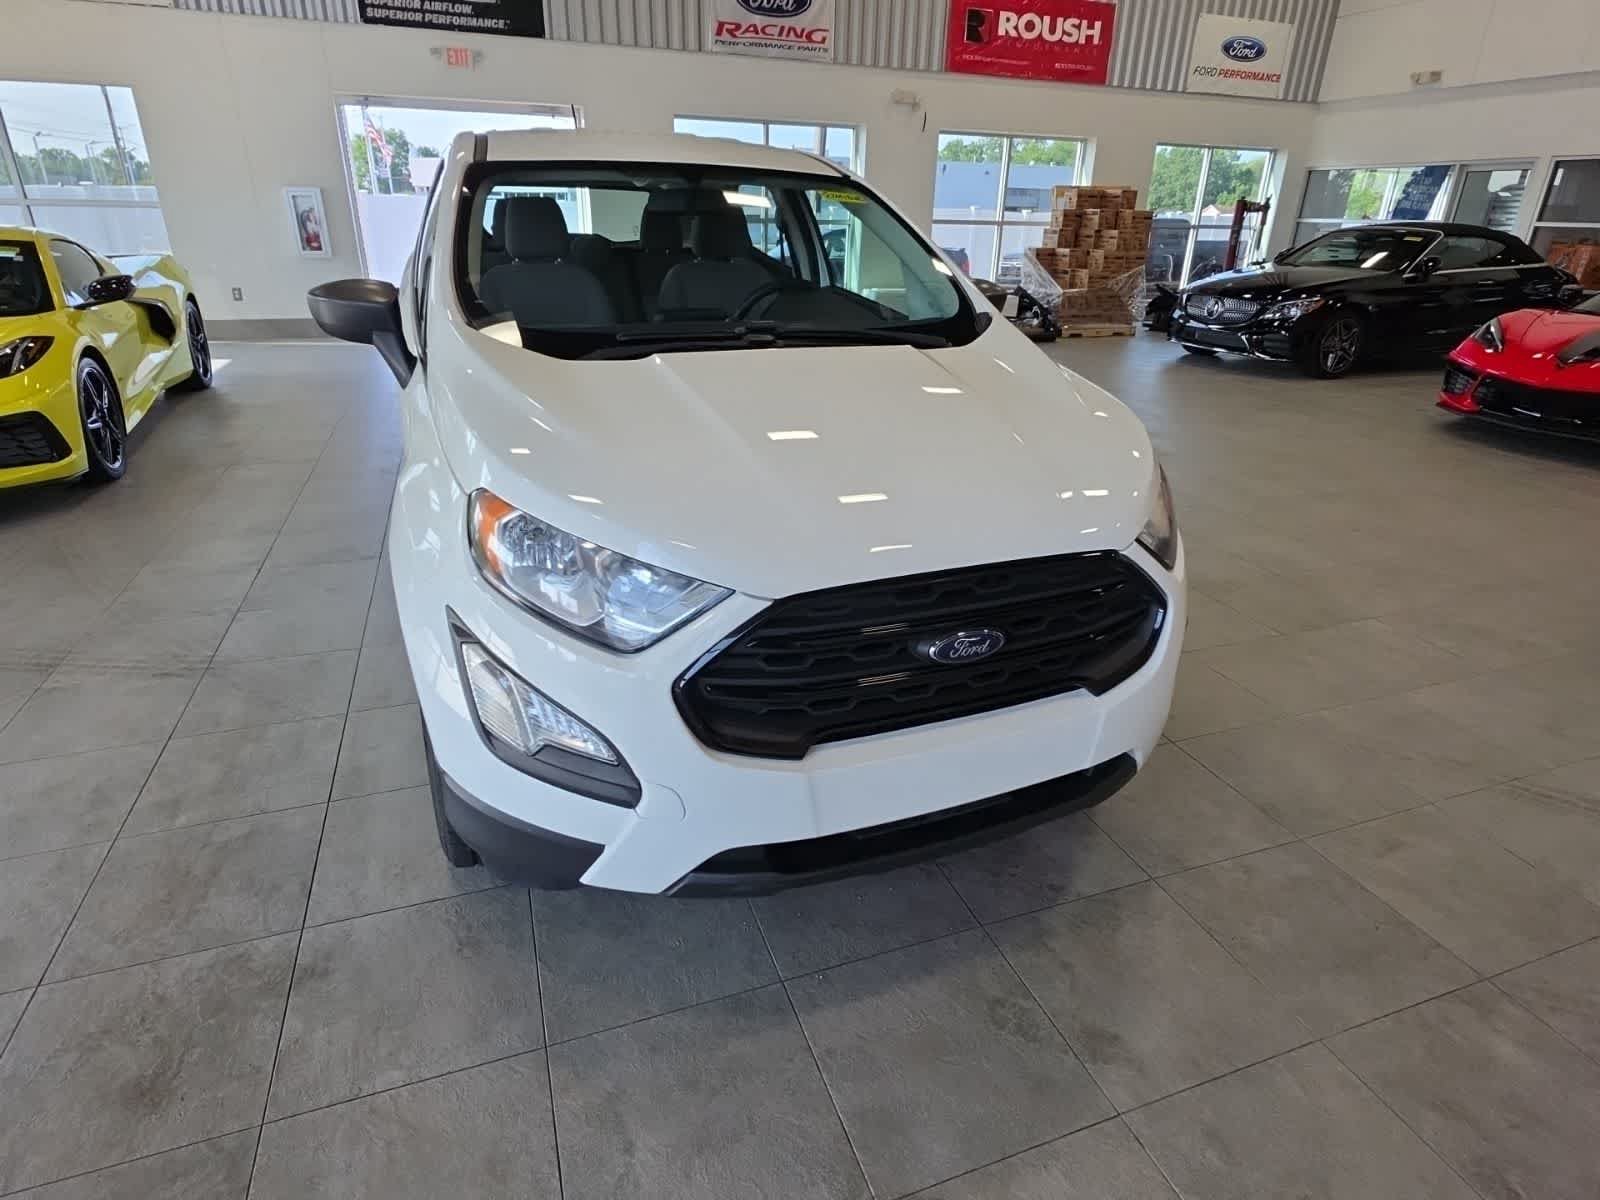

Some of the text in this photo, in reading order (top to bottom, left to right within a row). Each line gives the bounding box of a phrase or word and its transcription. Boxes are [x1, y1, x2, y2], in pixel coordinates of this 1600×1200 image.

[423, 1, 475, 15] AIRFLOW.
[750, 0, 797, 11] ord
[366, 7, 423, 22] SUPERIOR
[715, 20, 830, 44] RACING
[997, 10, 1102, 46] ROUSH
[715, 39, 829, 53] PERFORMANCE PARTS
[1229, 39, 1258, 58] Ford
[446, 48, 470, 65] EXIT
[1193, 65, 1281, 83] FORD PERFORMANCE
[950, 637, 991, 658] Ford
